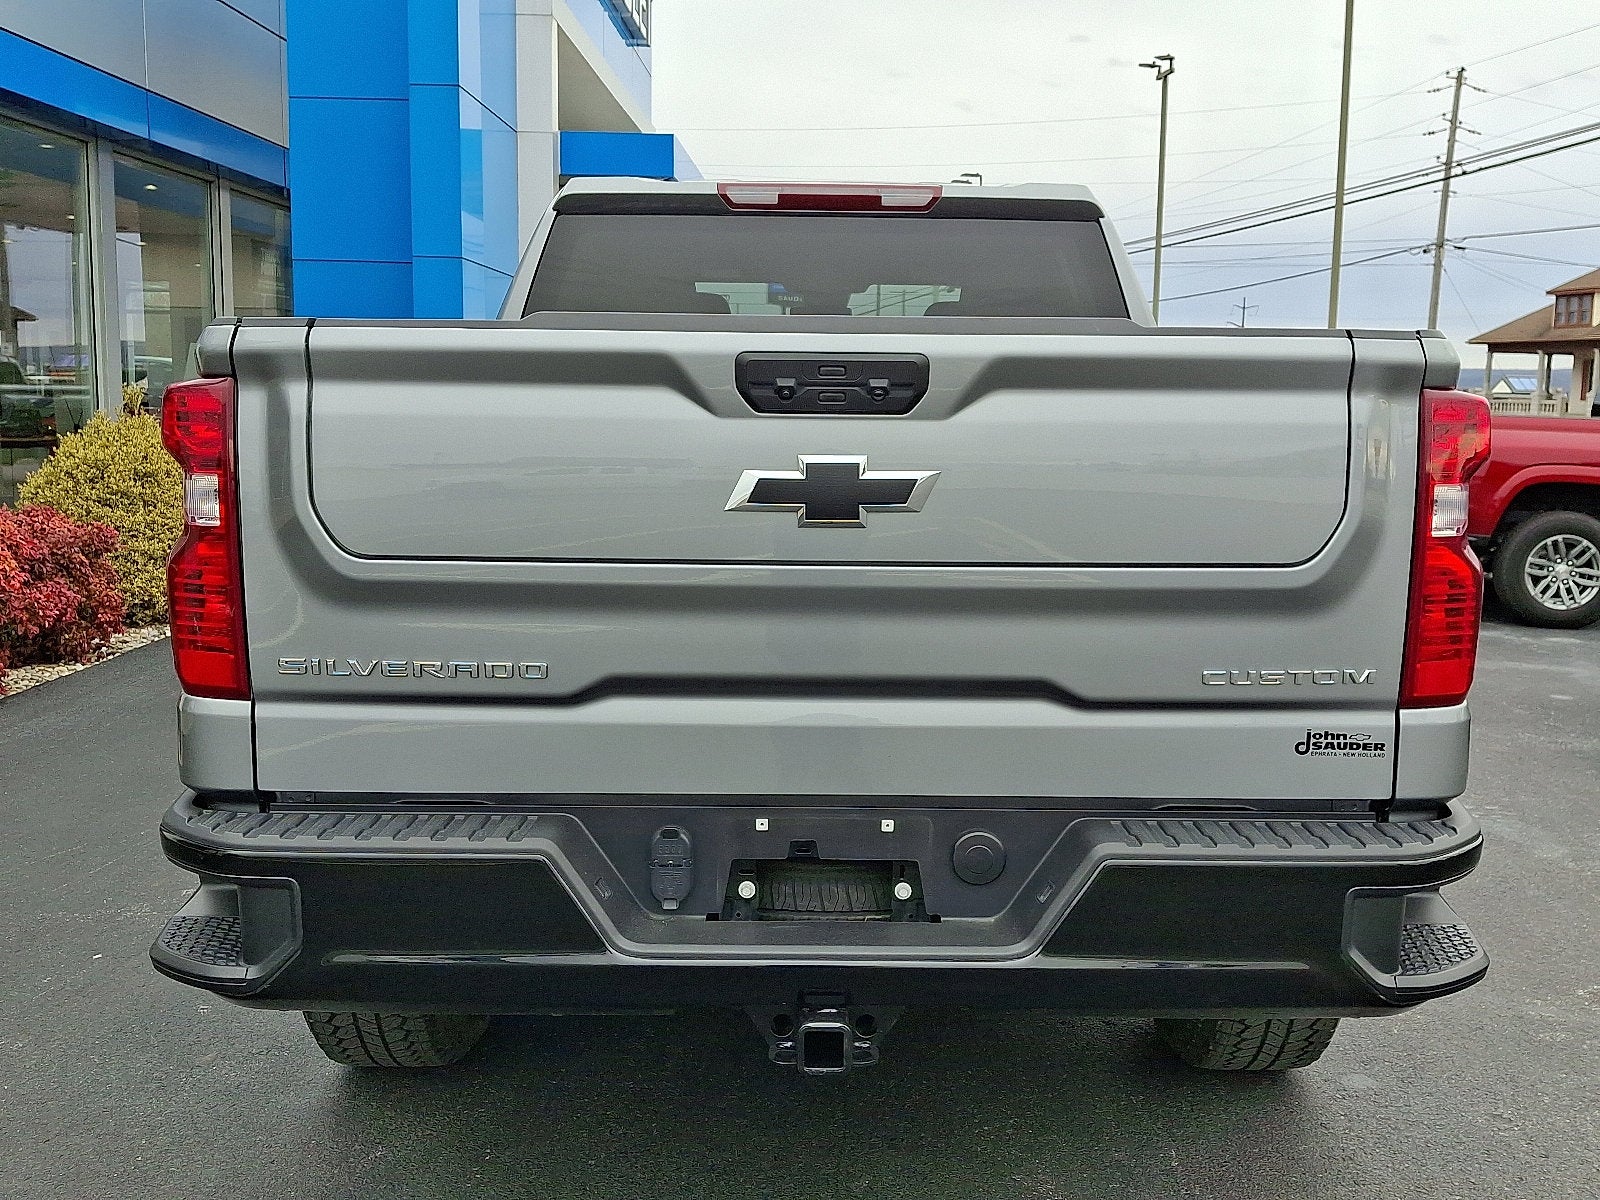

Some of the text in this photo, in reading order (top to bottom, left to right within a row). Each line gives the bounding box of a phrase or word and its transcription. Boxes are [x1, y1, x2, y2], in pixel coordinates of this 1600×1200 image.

[277, 657, 549, 679] SILVERADO
[1202, 669, 1377, 685] CUSTOM
[1312, 741, 1386, 752] SAUDER
